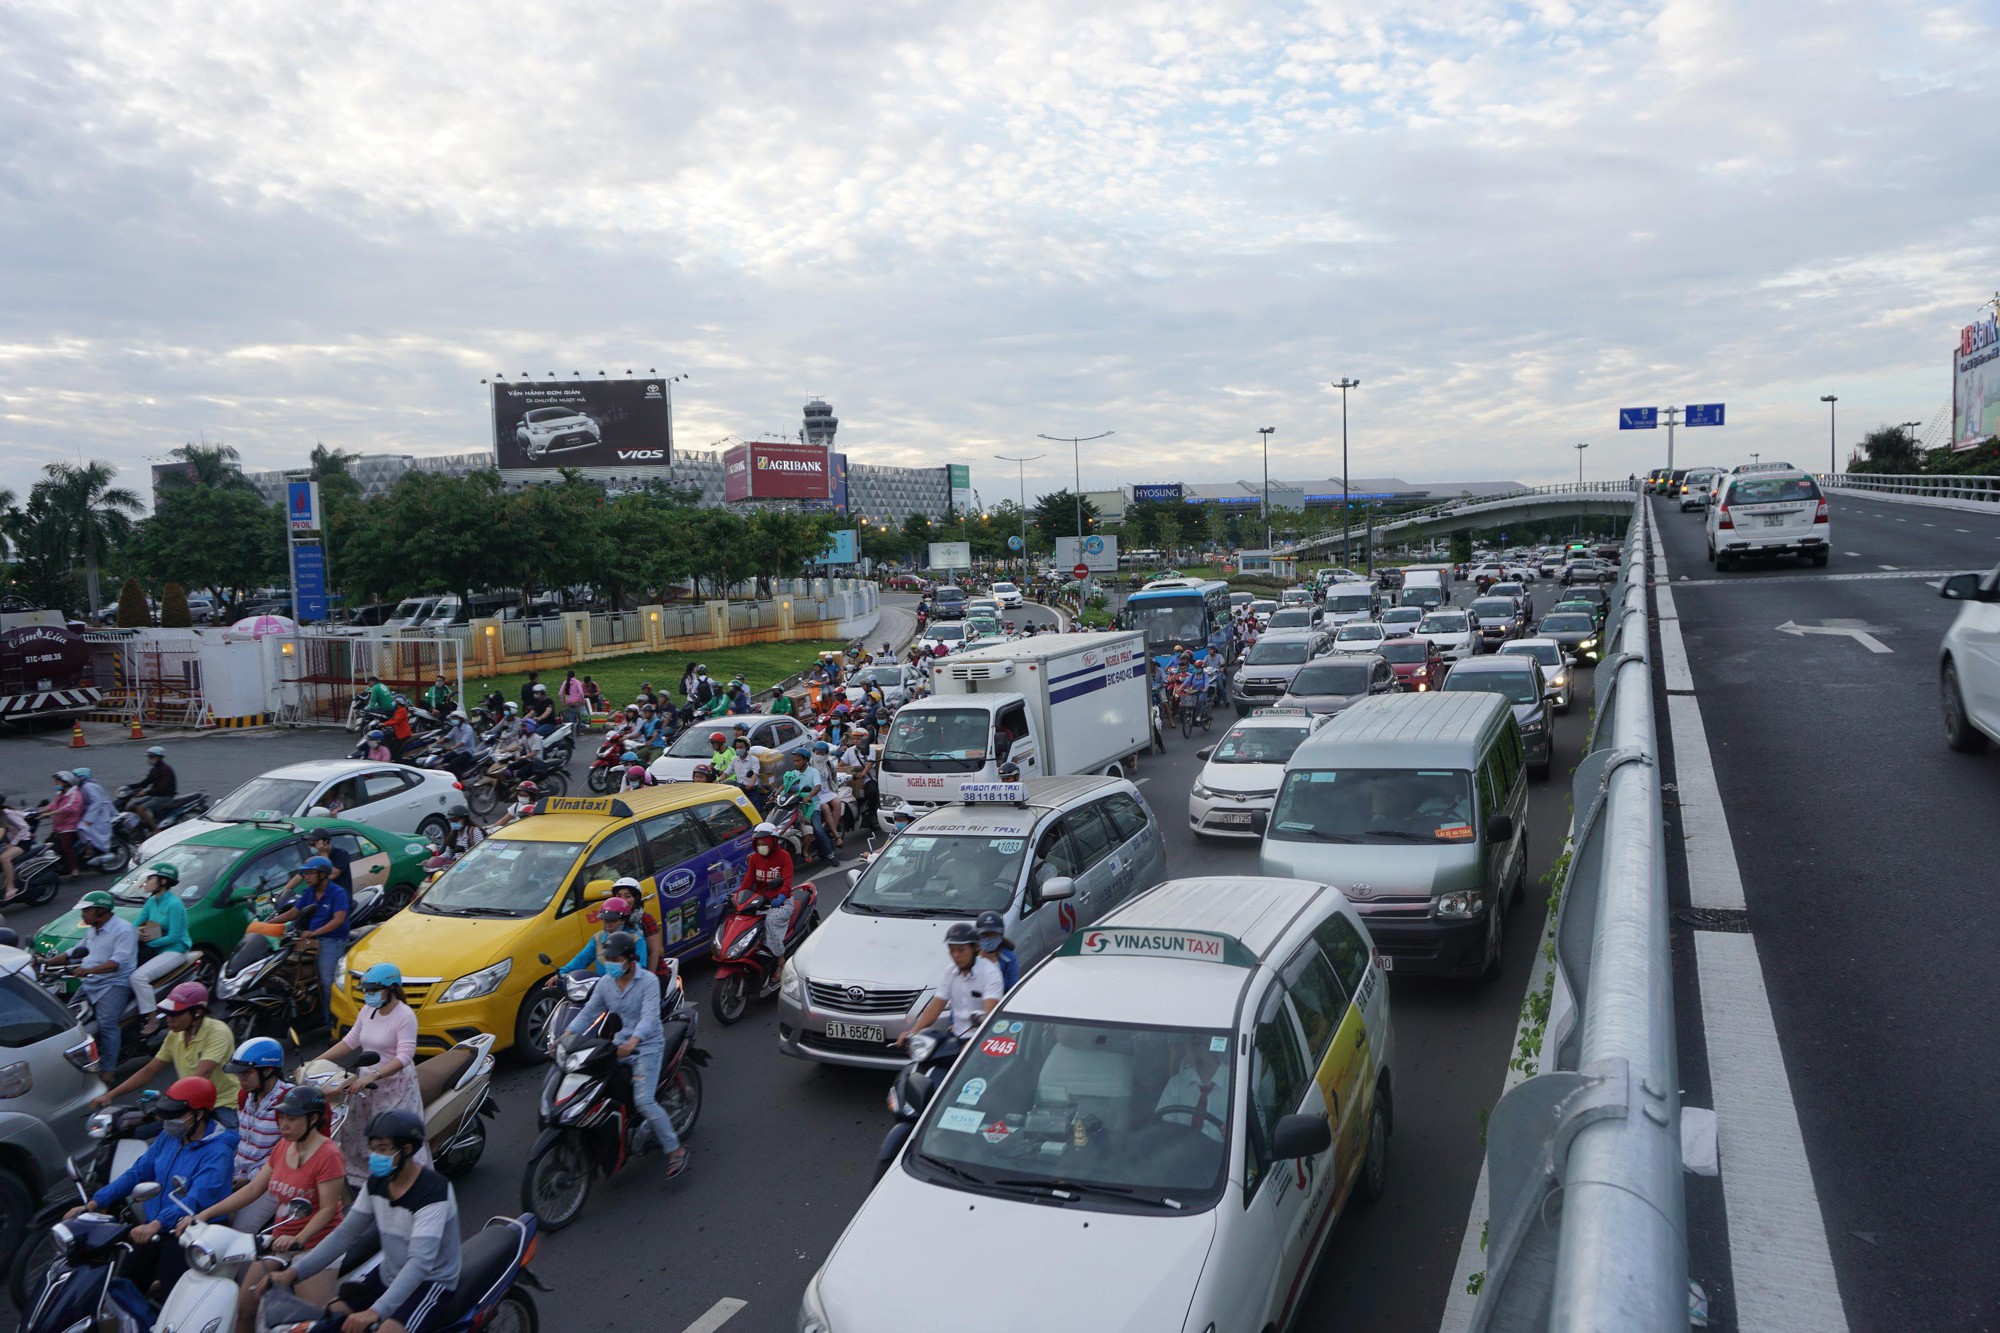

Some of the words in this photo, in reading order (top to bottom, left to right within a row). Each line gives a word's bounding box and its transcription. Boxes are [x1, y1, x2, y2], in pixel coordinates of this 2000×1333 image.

[617, 450, 664, 460] VIOS
[768, 460, 822, 472] AGRIBANK
[1136, 488, 1179, 498] HYOSUNG
[928, 775, 944, 788] PHÁT
[960, 784, 990, 792] SAIGON
[552, 799, 608, 810] Vinataxi
[917, 824, 966, 832] SAIGON
[993, 826, 1020, 834] TAXI
[1000, 841, 1019, 851] 1033
[982, 1040, 1016, 1054] 7445
